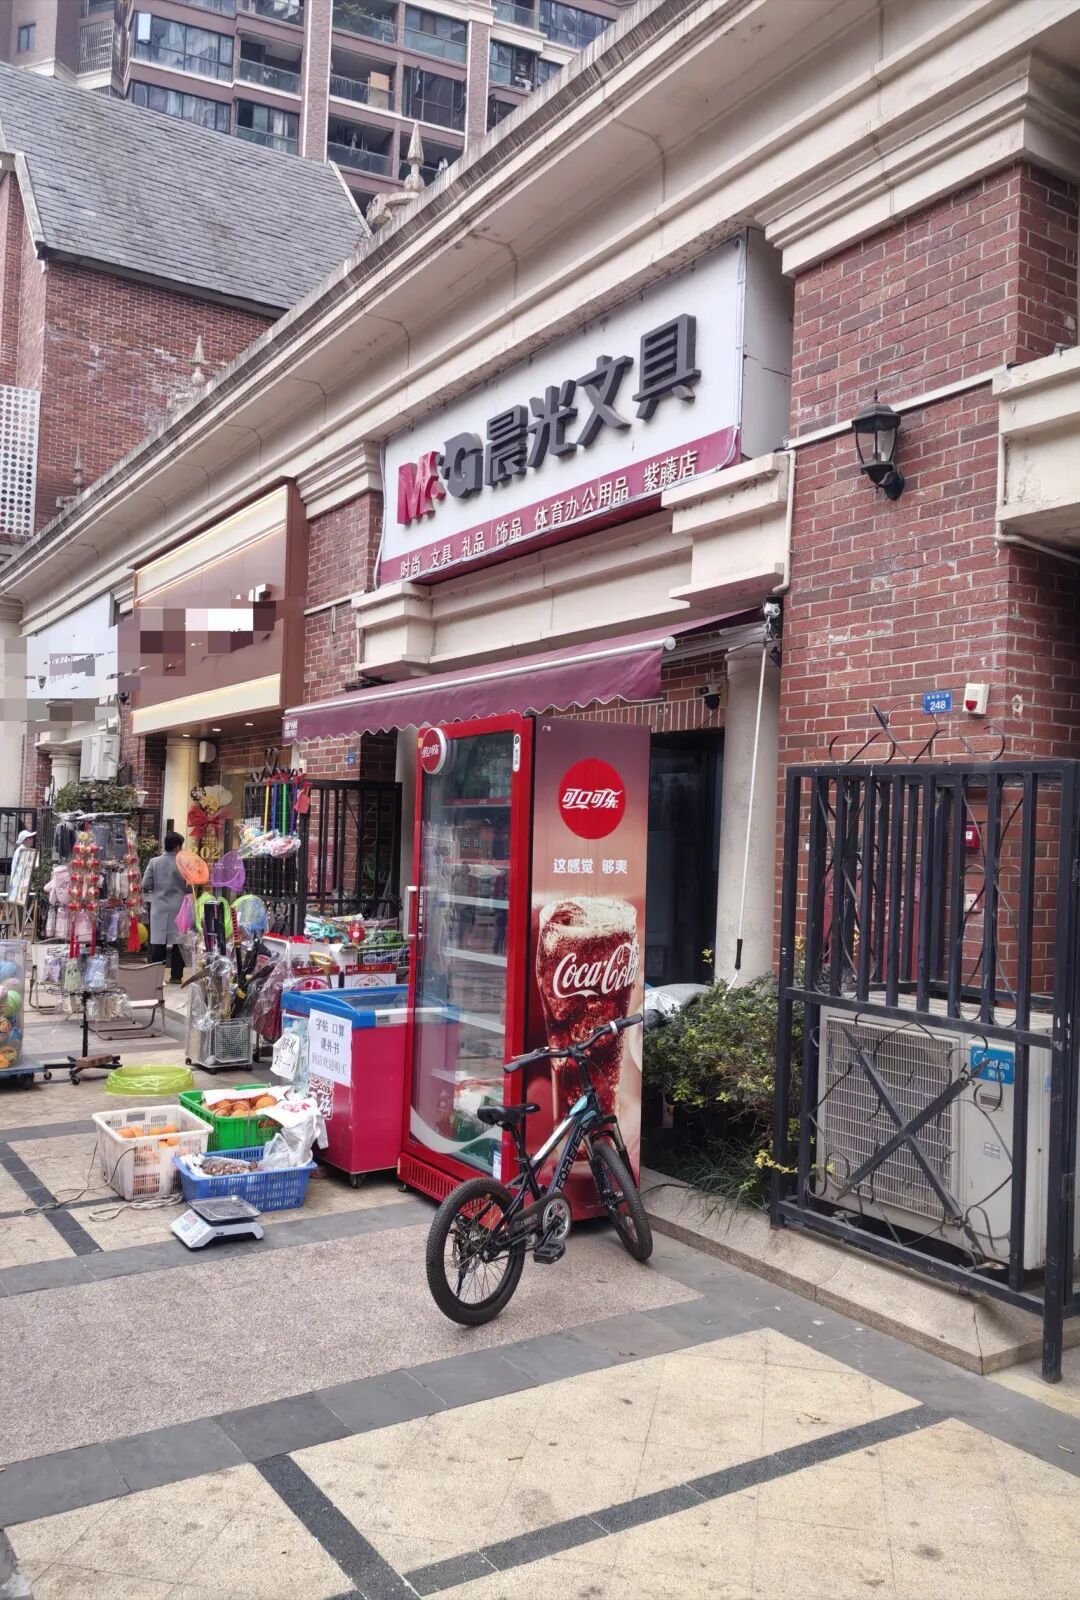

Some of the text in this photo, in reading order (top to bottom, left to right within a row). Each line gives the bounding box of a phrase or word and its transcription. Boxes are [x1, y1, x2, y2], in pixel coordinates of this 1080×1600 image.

[485, 313, 701, 487] 晨光文具
[400, 450, 698, 578] 时尚 文具 礼品 饰品 体育办公用品 紫藤店
[929, 700, 946, 711] 248
[561, 787, 623, 809] 可口可乐
[553, 858, 628, 875] 这感觉 够爽
[320, 1037, 340, 1055] 课外书
